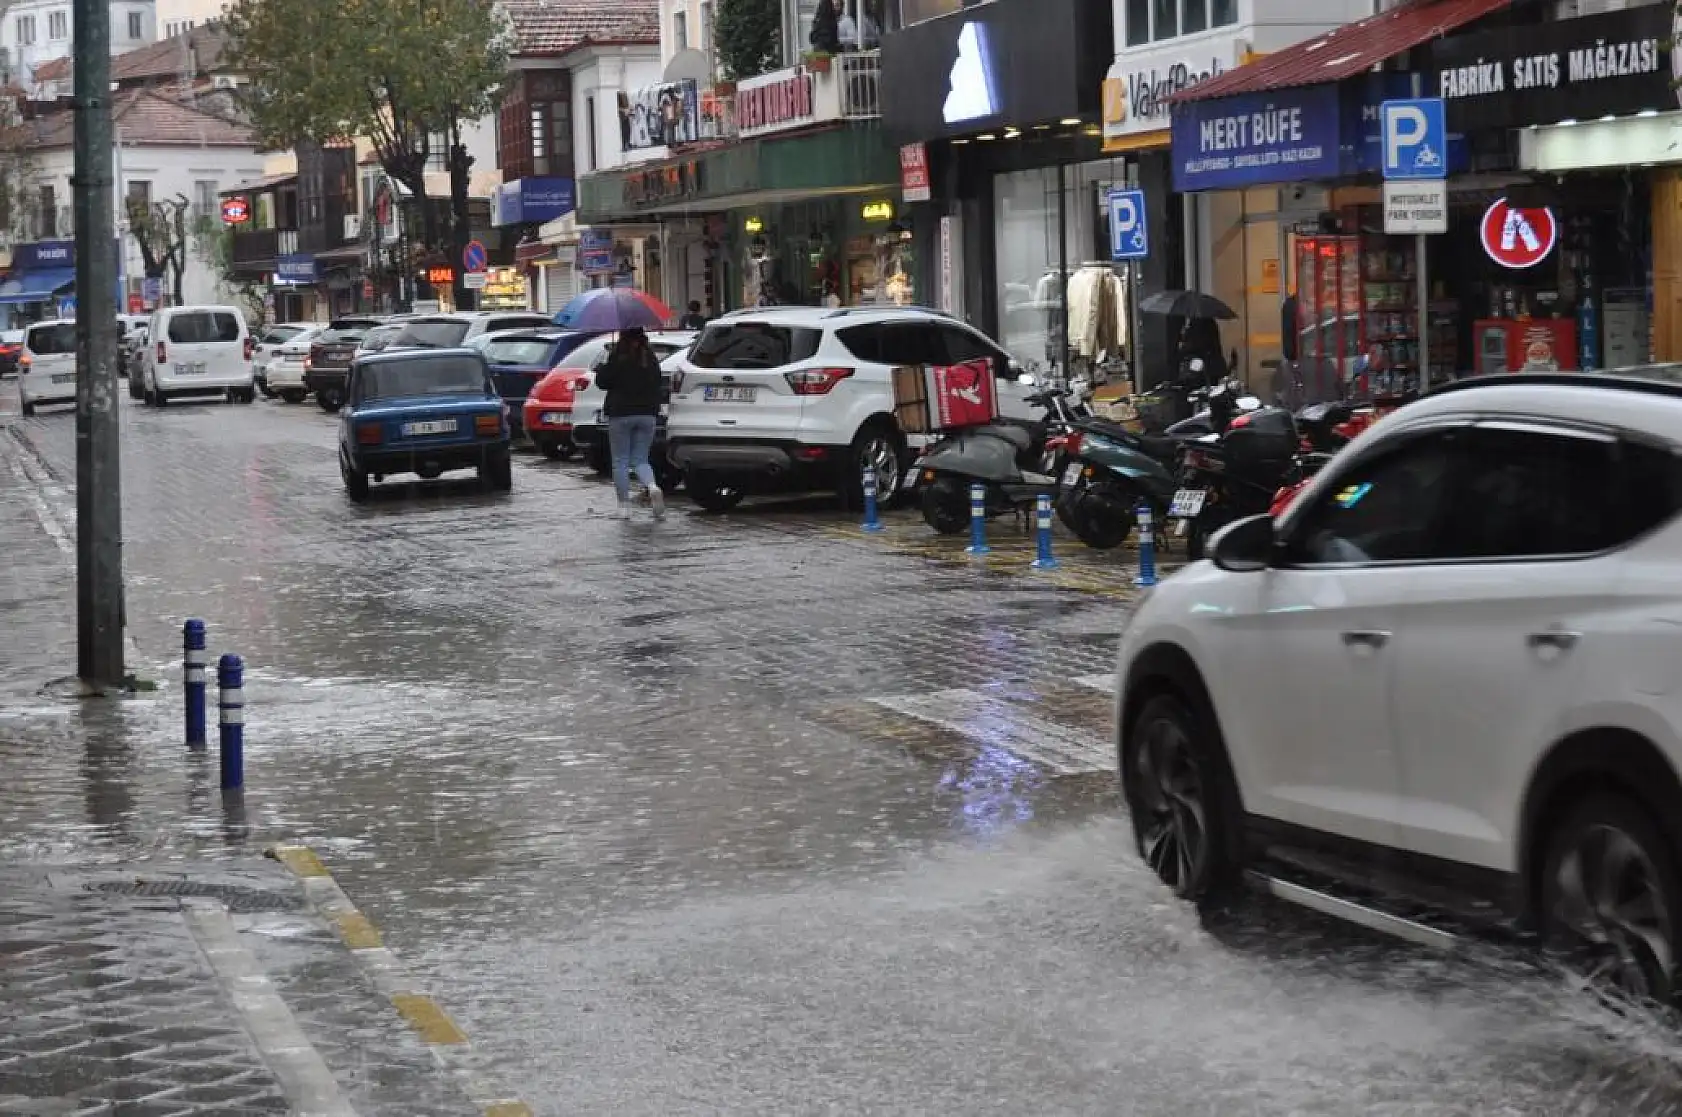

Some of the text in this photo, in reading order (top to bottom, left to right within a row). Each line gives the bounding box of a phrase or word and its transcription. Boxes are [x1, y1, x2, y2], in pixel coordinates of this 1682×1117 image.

[1440, 57, 1504, 98] FABRİKA
[1513, 53, 1559, 88] SATIŞ
[1200, 104, 1302, 152] MERT BÜFE
[1386, 106, 1428, 169] P
[1112, 199, 1136, 249] P
